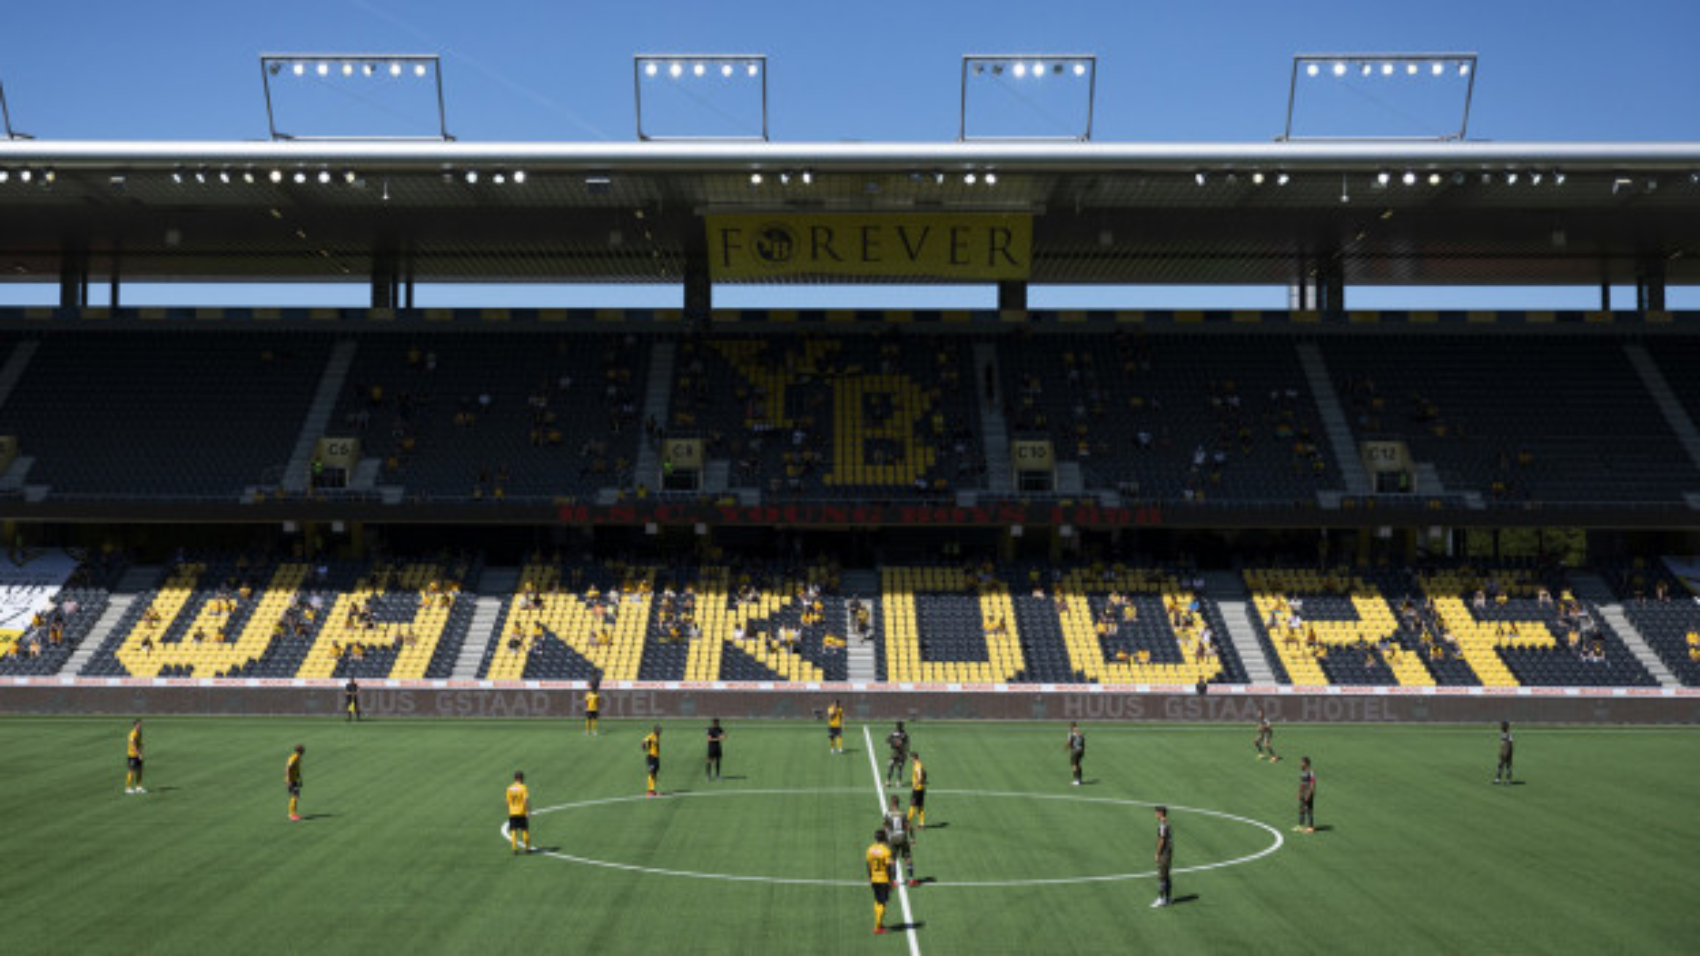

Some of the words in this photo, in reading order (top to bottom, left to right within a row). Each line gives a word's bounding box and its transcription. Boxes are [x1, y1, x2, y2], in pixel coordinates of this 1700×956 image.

[435, 691, 550, 714] GSTAAD
[1063, 695, 1145, 717] HUUS
[1301, 697, 1399, 720] HOTEL
